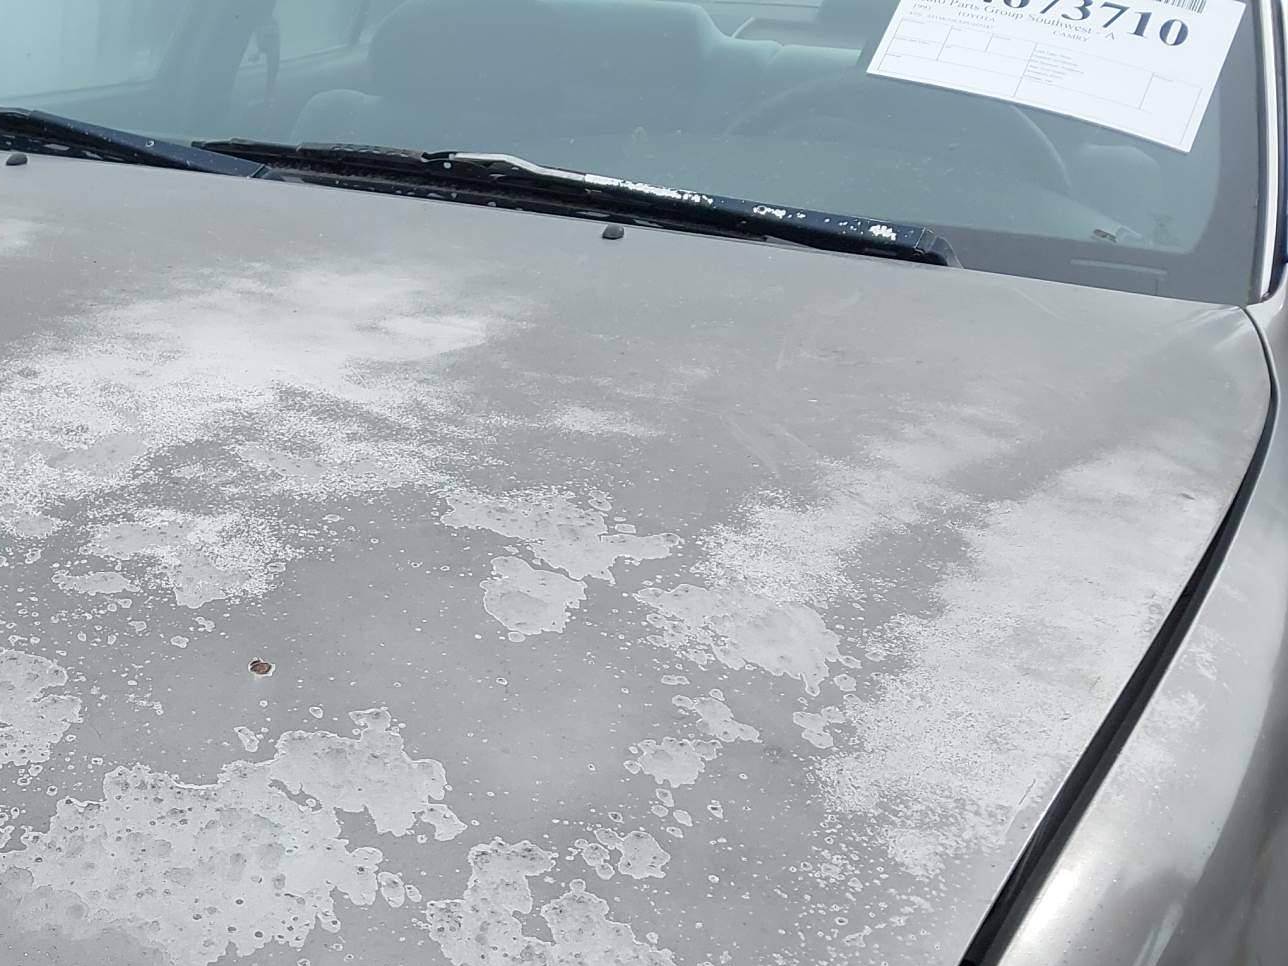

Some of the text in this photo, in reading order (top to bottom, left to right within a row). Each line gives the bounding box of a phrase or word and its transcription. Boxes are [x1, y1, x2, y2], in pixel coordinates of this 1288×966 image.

[949, 0, 980, 10] Parts
[983, 5, 1024, 20] Group
[1028, 13, 1092, 34] Southwest
[958, 11, 995, 23] TOYOTA
[1052, 29, 1089, 42] CAMRY
